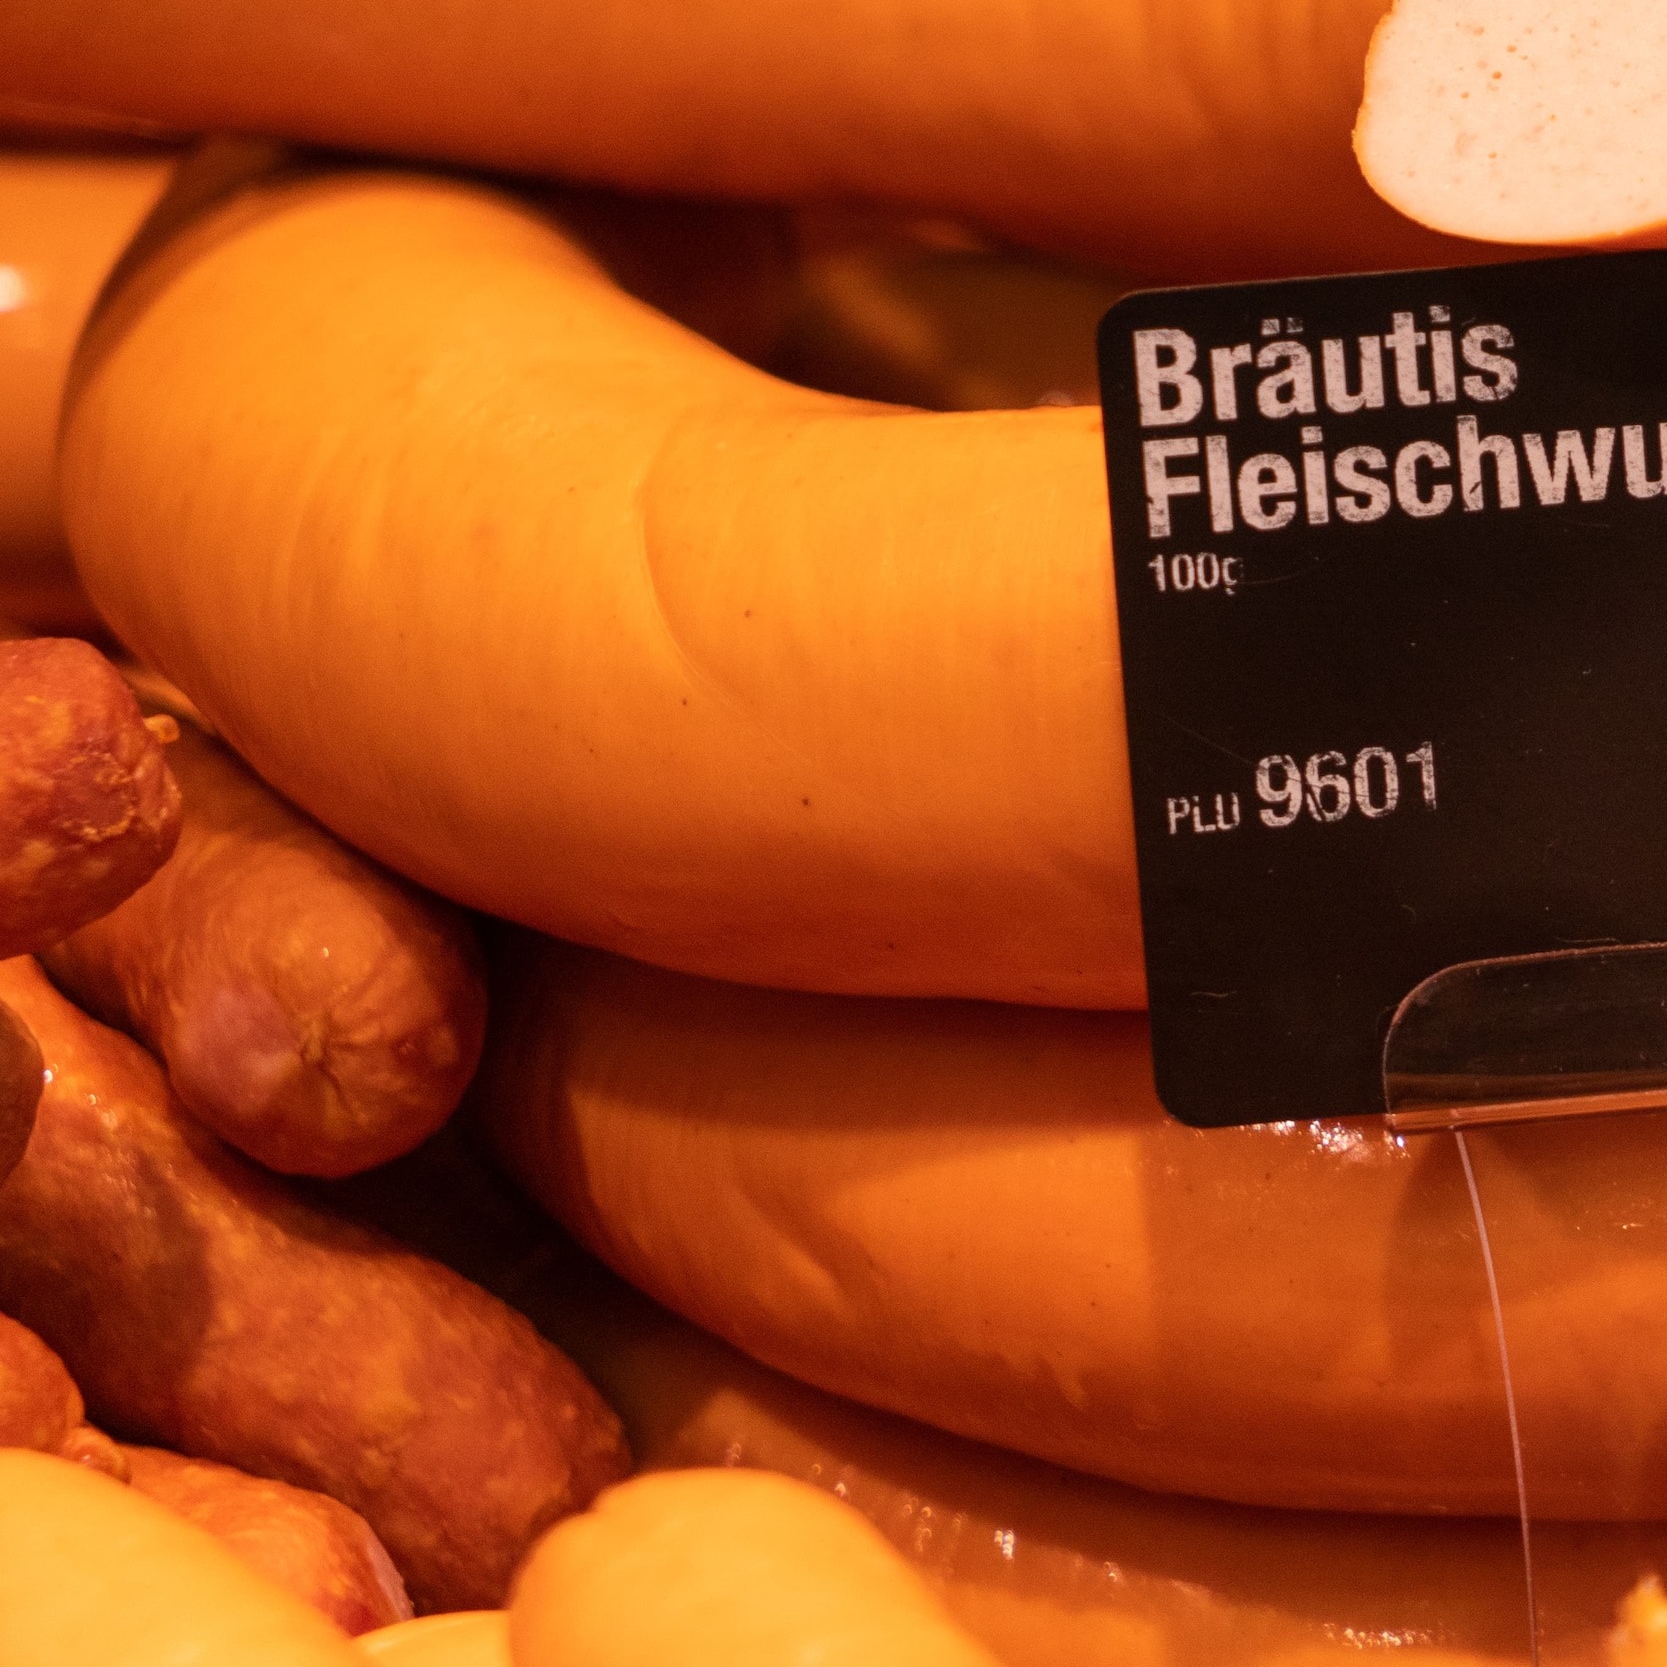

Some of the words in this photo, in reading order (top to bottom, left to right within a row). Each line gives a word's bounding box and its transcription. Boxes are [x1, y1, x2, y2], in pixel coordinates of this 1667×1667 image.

[1133, 305, 1518, 427] Bräutis
[1167, 792, 1240, 834] PLU
[1255, 741, 1437, 828] 9601
